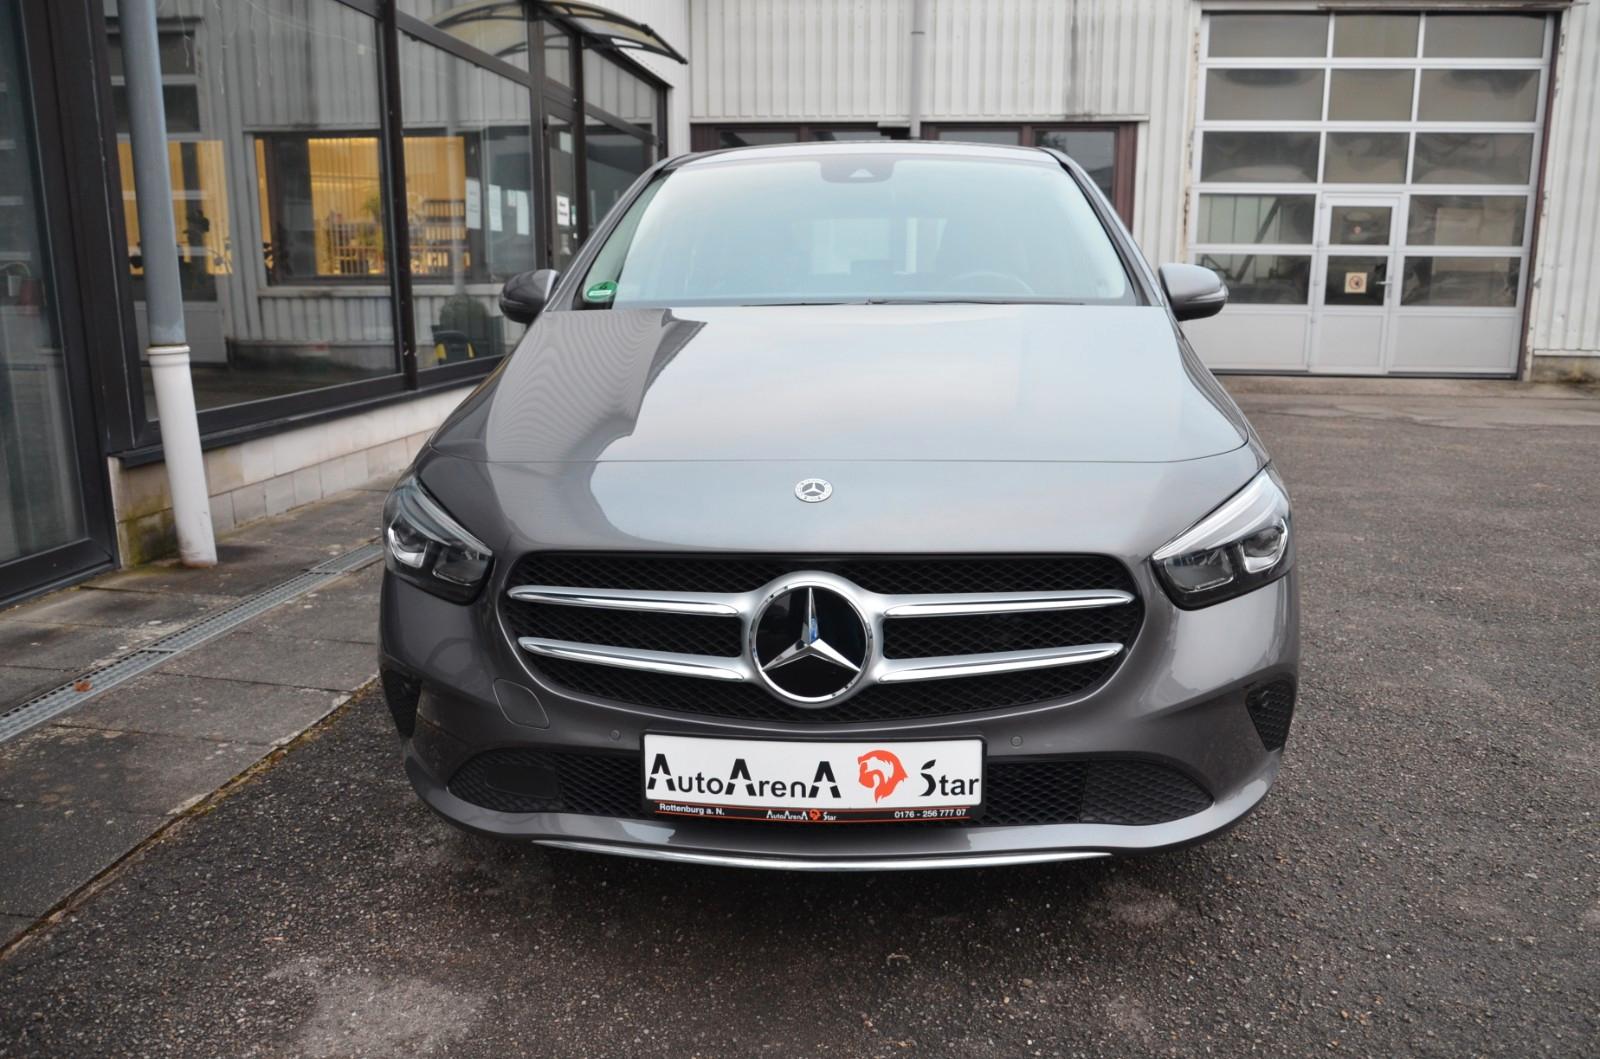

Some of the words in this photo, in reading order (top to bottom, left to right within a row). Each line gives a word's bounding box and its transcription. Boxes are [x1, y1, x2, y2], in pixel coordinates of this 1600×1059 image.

[647, 753, 841, 798] AutoArenA
[919, 759, 979, 797] Star
[659, 803, 704, 815] Rottenburg
[706, 807, 714, 815] a.
[715, 807, 725, 815] N.
[894, 811, 915, 819] 0176
[940, 809, 954, 817] 777
[956, 808, 967, 816] 07
[823, 811, 837, 820] Star
